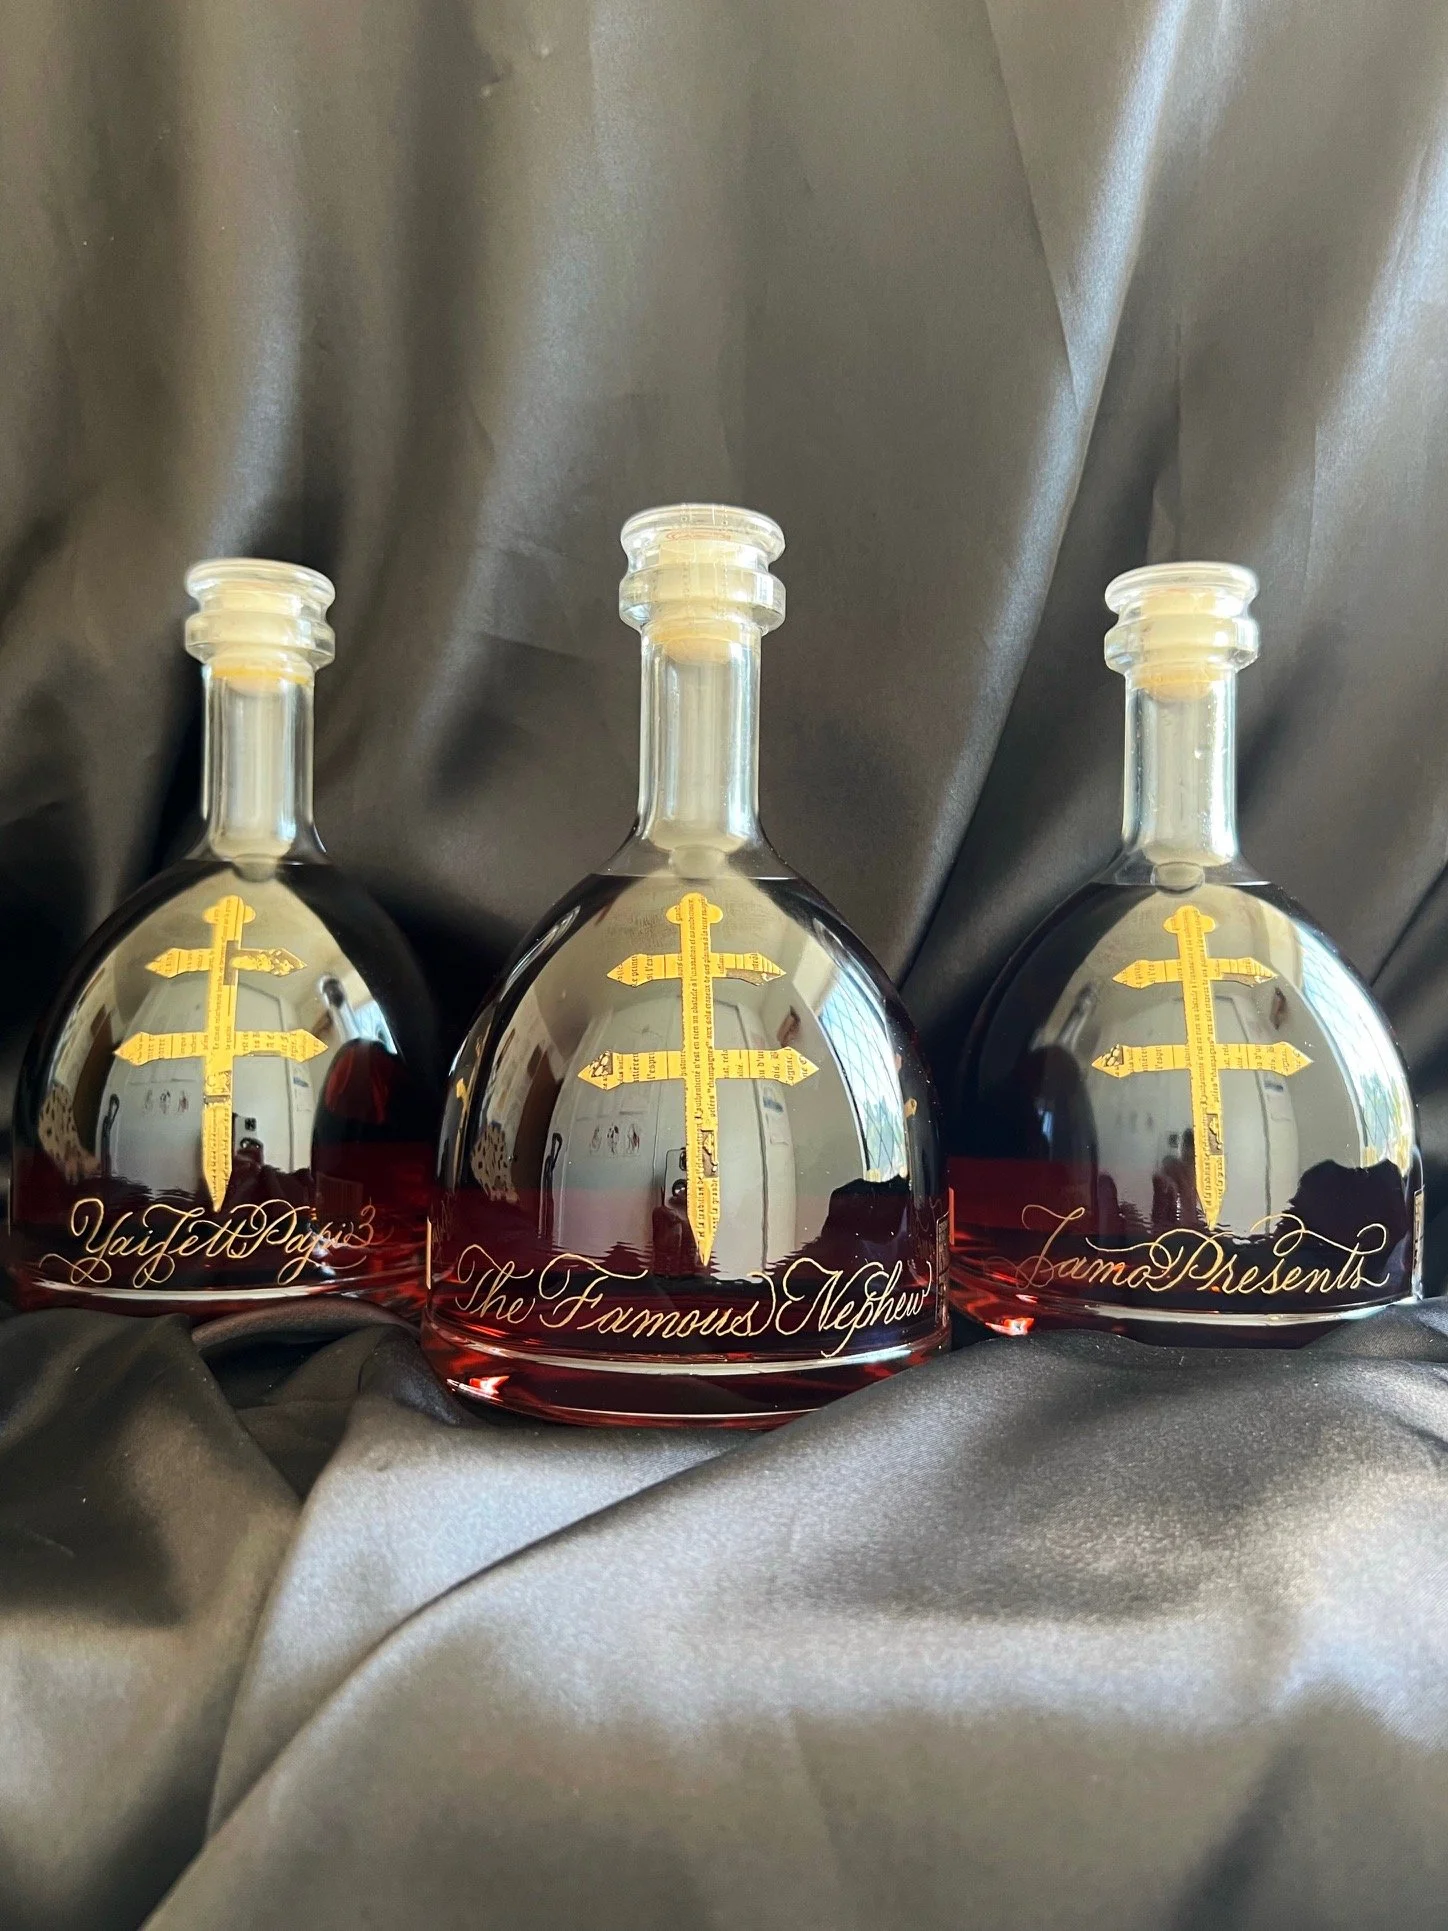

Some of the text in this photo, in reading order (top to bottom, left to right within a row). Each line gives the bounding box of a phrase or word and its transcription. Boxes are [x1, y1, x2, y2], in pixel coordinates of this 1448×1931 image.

[455, 1244, 932, 1357] The Famous Nephew
[1143, 1213, 1390, 1294] Presents
